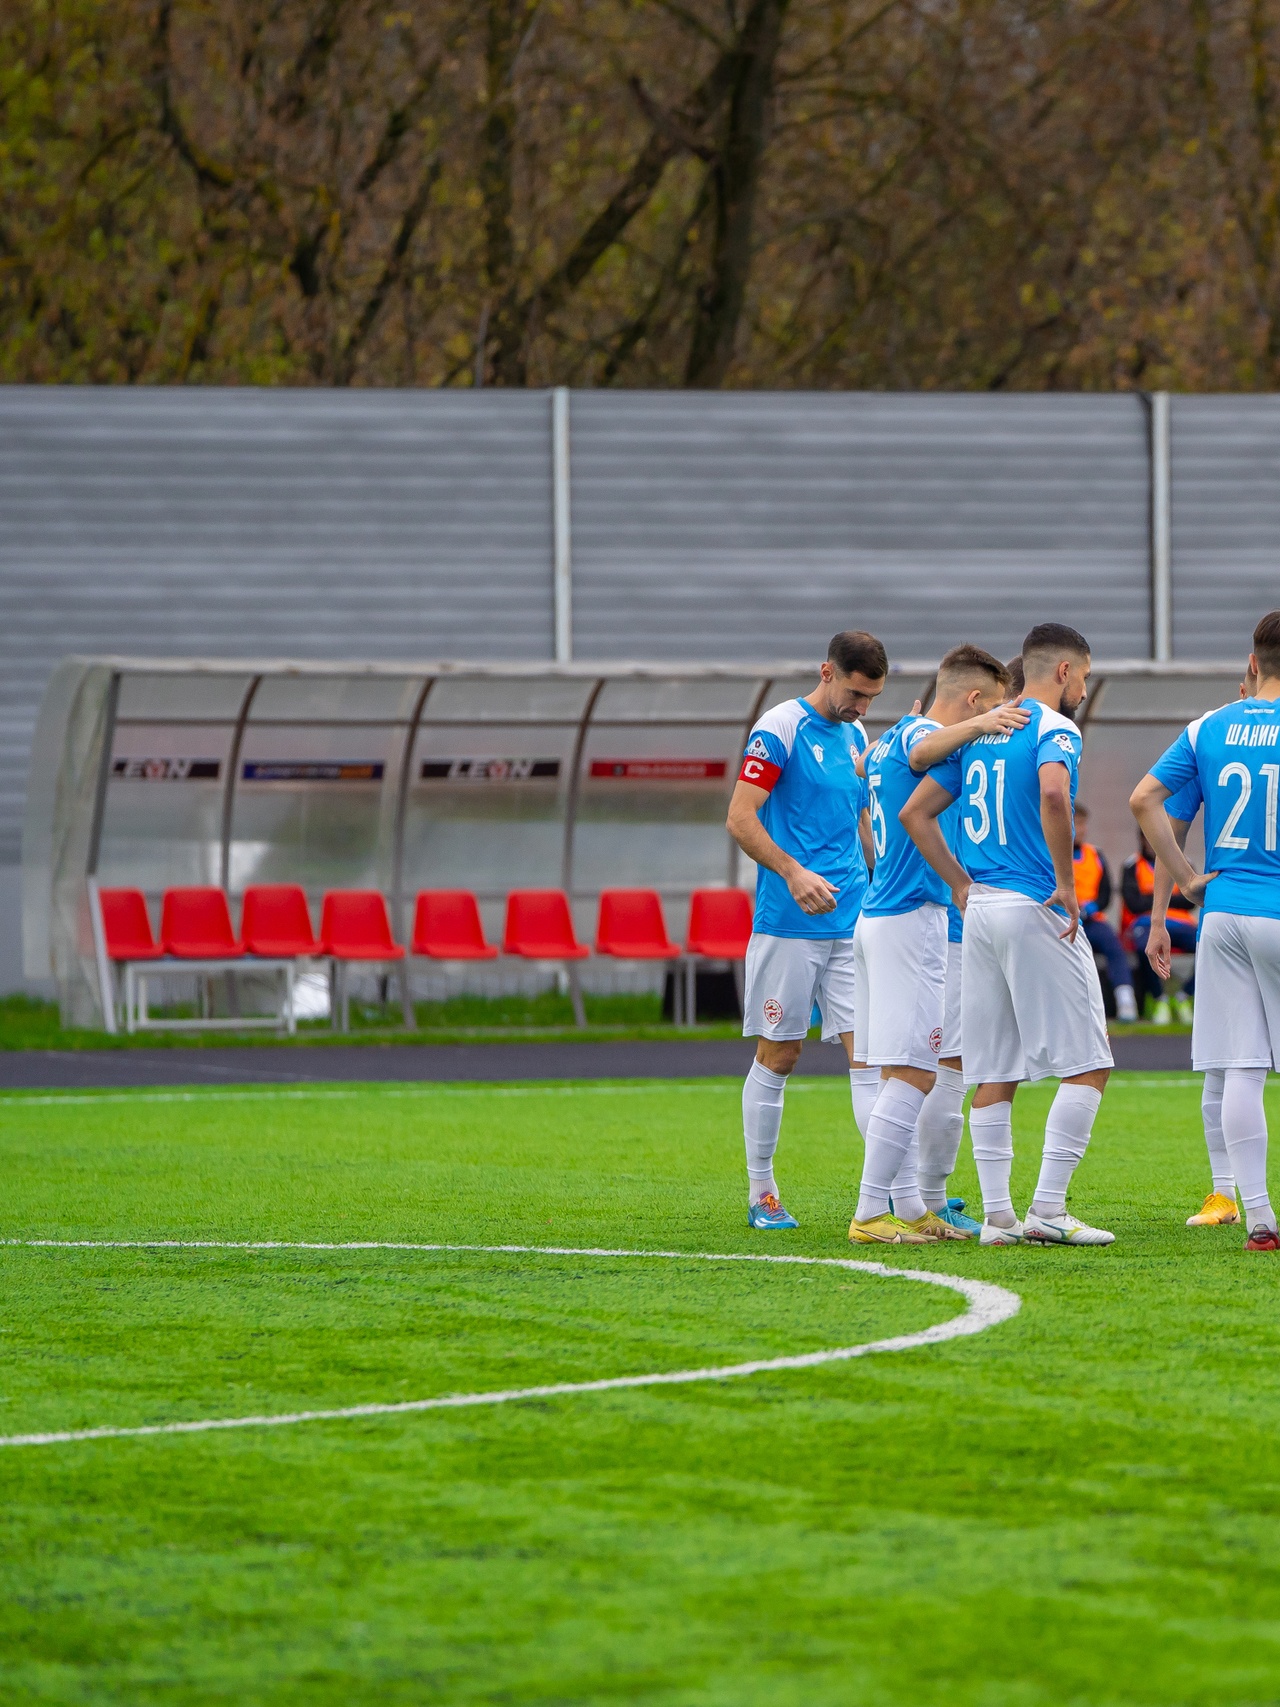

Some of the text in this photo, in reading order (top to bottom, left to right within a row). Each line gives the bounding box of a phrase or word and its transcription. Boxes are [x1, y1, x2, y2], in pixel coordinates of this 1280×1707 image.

[1225, 723, 1280, 747] ШАНИН
[447, 758, 536, 779] LEON
[744, 760, 764, 779] C
[963, 759, 1008, 846] 31
[1214, 761, 1280, 851] 21
